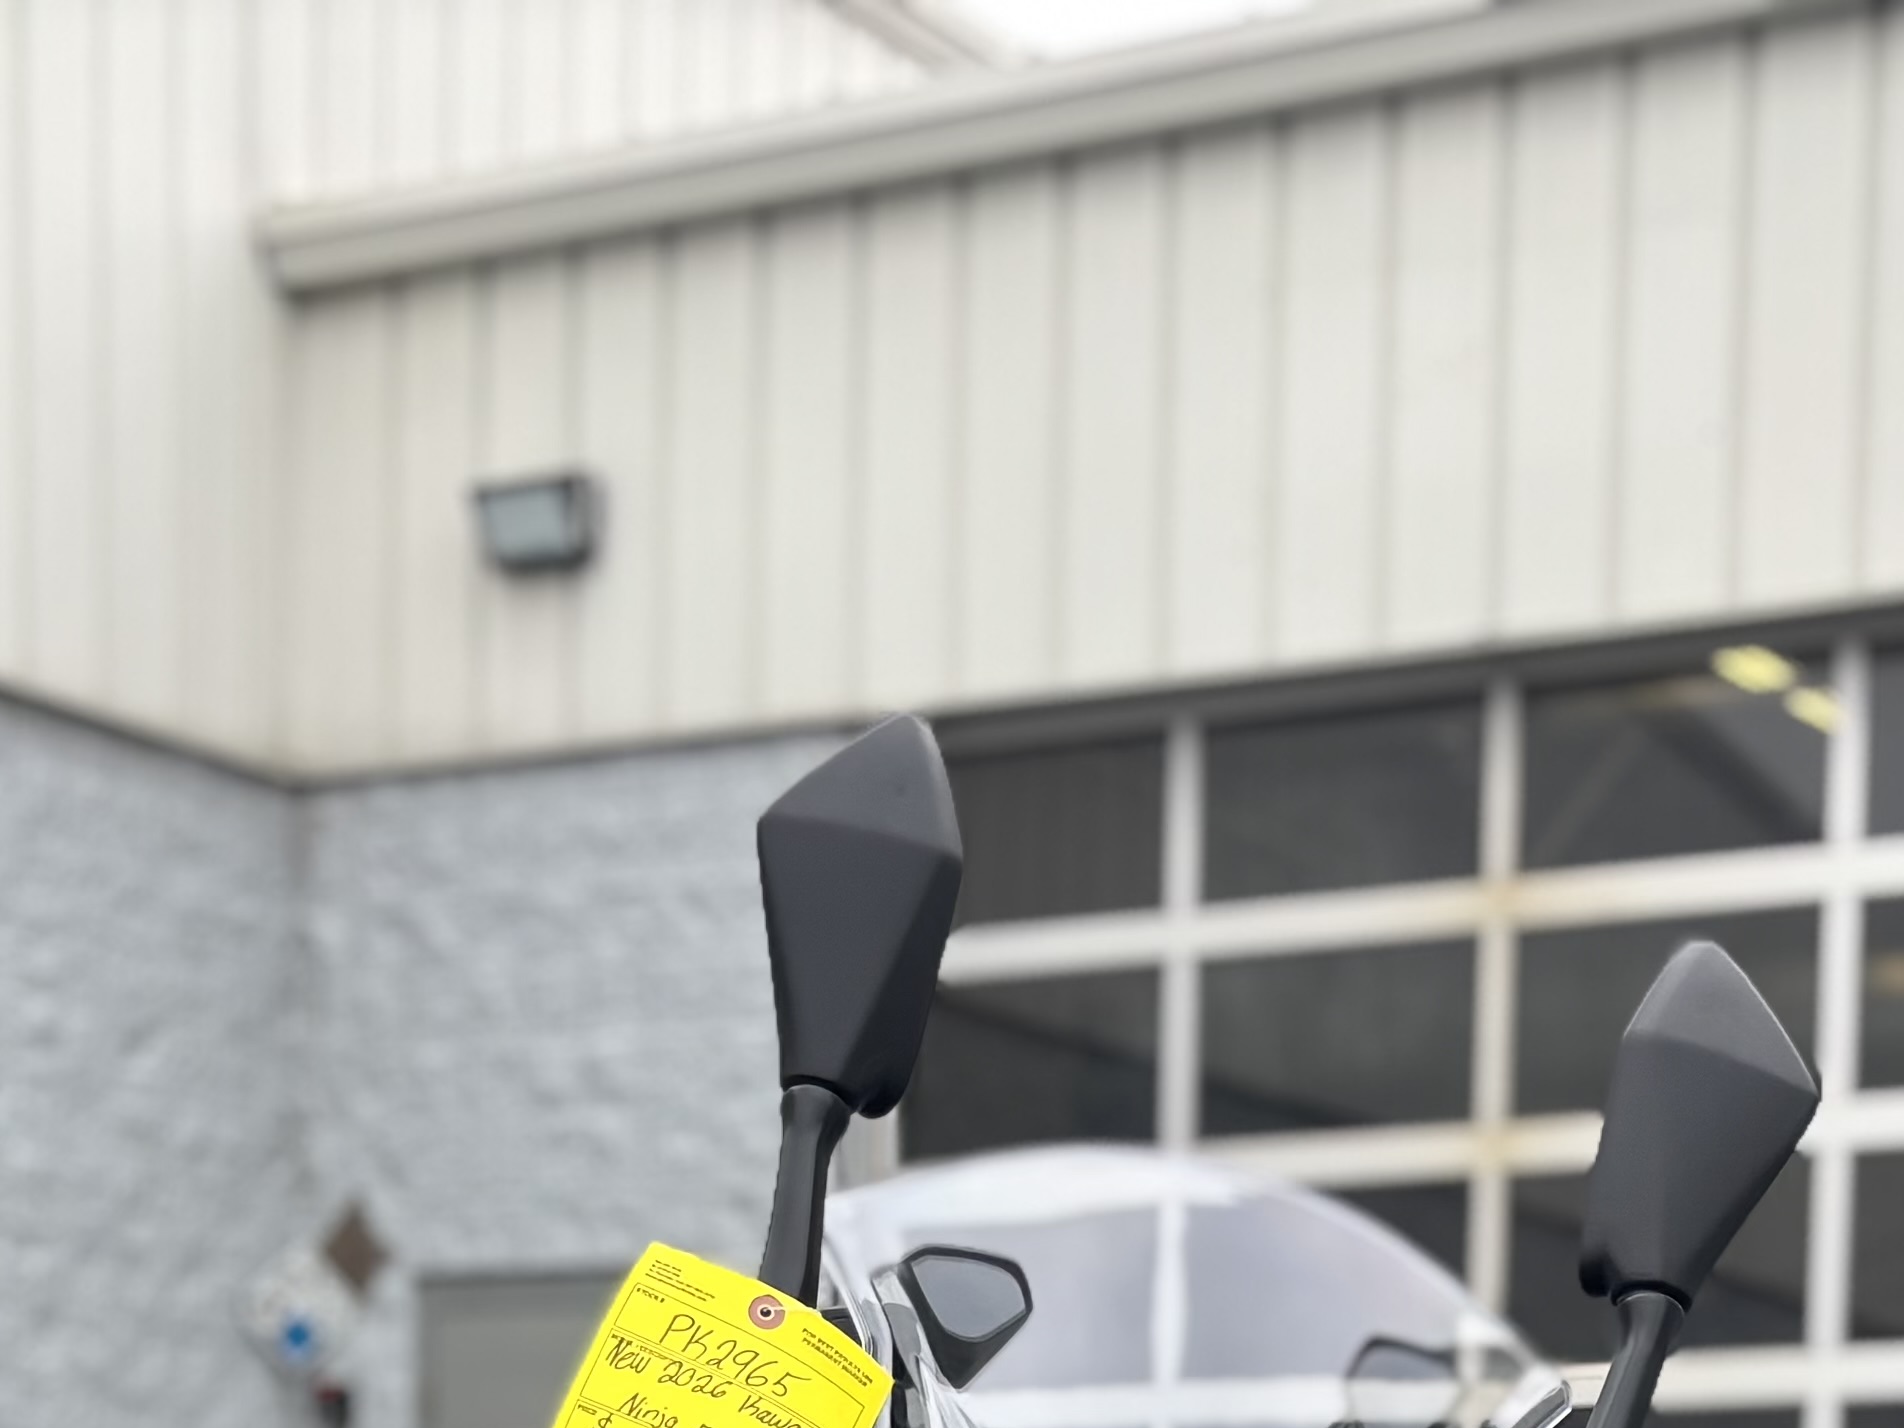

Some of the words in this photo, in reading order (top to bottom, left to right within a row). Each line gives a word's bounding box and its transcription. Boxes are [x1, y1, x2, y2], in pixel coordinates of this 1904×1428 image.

[605, 1337, 652, 1374] New
[657, 1360, 734, 1398] 2026
[658, 1313, 813, 1398] PK2965
